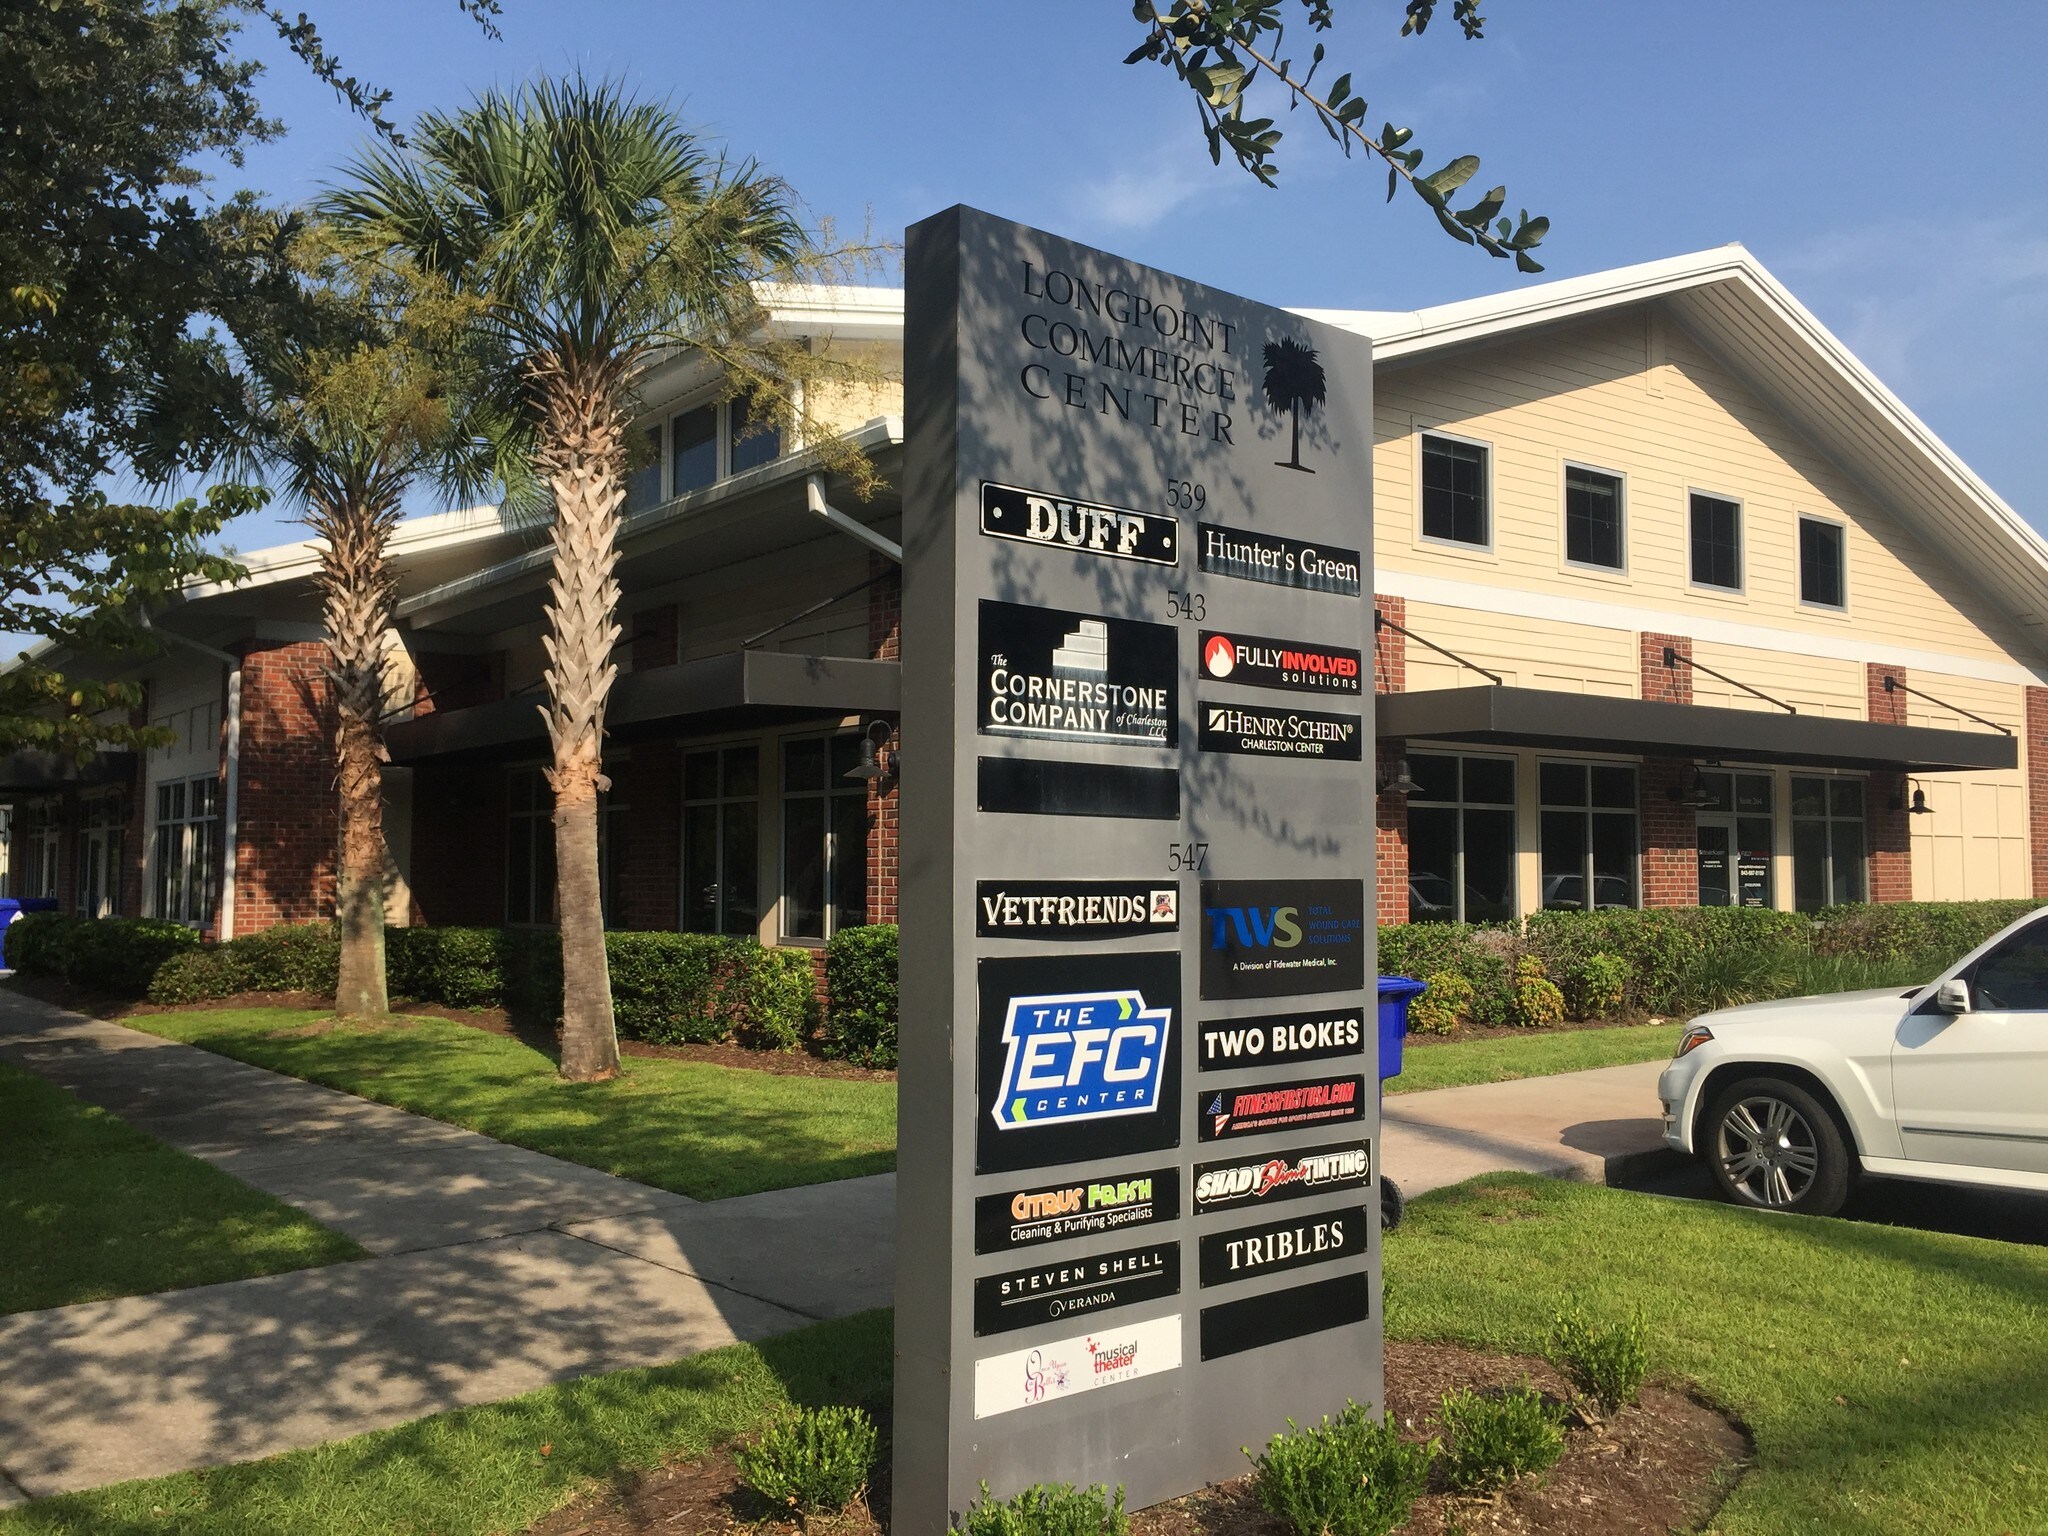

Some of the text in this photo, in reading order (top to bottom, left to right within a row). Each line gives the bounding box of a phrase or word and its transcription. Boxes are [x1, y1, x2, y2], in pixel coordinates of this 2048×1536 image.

[1021, 260, 1236, 354] LONGPOINT
[1021, 313, 1236, 401] COMMERCE
[1020, 363, 1236, 446] CENTER
[1166, 478, 1206, 512] 539
[1025, 495, 1145, 555] DUFF
[1205, 529, 1358, 583] Hunter's Green
[1166, 590, 1206, 621] 543
[990, 653, 1008, 667] The
[990, 668, 1168, 710] CORNERSTONE
[1282, 671, 1358, 690] solutions
[990, 696, 1168, 731] COMPANY of Charleston
[1226, 710, 1286, 738] HENRY
[1148, 727, 1168, 739] LLC
[1241, 738, 1324, 754] CHARLESTON CENTER
[1168, 843, 1209, 872] 547
[982, 891, 1146, 926] VETFRIENDS
[1308, 905, 1333, 916] TOTAL
[1308, 919, 1361, 930] WOUND CARE
[1205, 906, 1303, 950] TWS
[1308, 933, 1352, 944] SOLUTIONS
[1233, 962, 1239, 971] A
[1240, 961, 1264, 971] Division
[1265, 960, 1272, 969] of
[1273, 959, 1302, 969] Tidewater
[1033, 1006, 1095, 1028] THE
[1204, 1018, 1360, 1059] TWO BLOKES
[1016, 1025, 1157, 1092] EFC
[1036, 1088, 1145, 1112] CENTER
[1233, 1081, 1356, 1118] FITNESSFIRSTUSA.COM
[1197, 1165, 1264, 1204] SHADY
[1303, 1150, 1368, 1186] TINTING
[1011, 1178, 1153, 1221] CITRUS FRESH
[1010, 1207, 1153, 1241] Cleaning & Purifying Specialists
[1226, 1220, 1344, 1270] TRIBLES
[1001, 1253, 1163, 1295] STEVEN SHELL
[1094, 1340, 1138, 1362] musical
[1094, 1352, 1135, 1374] theater
[1094, 1368, 1139, 1386] CENTER
